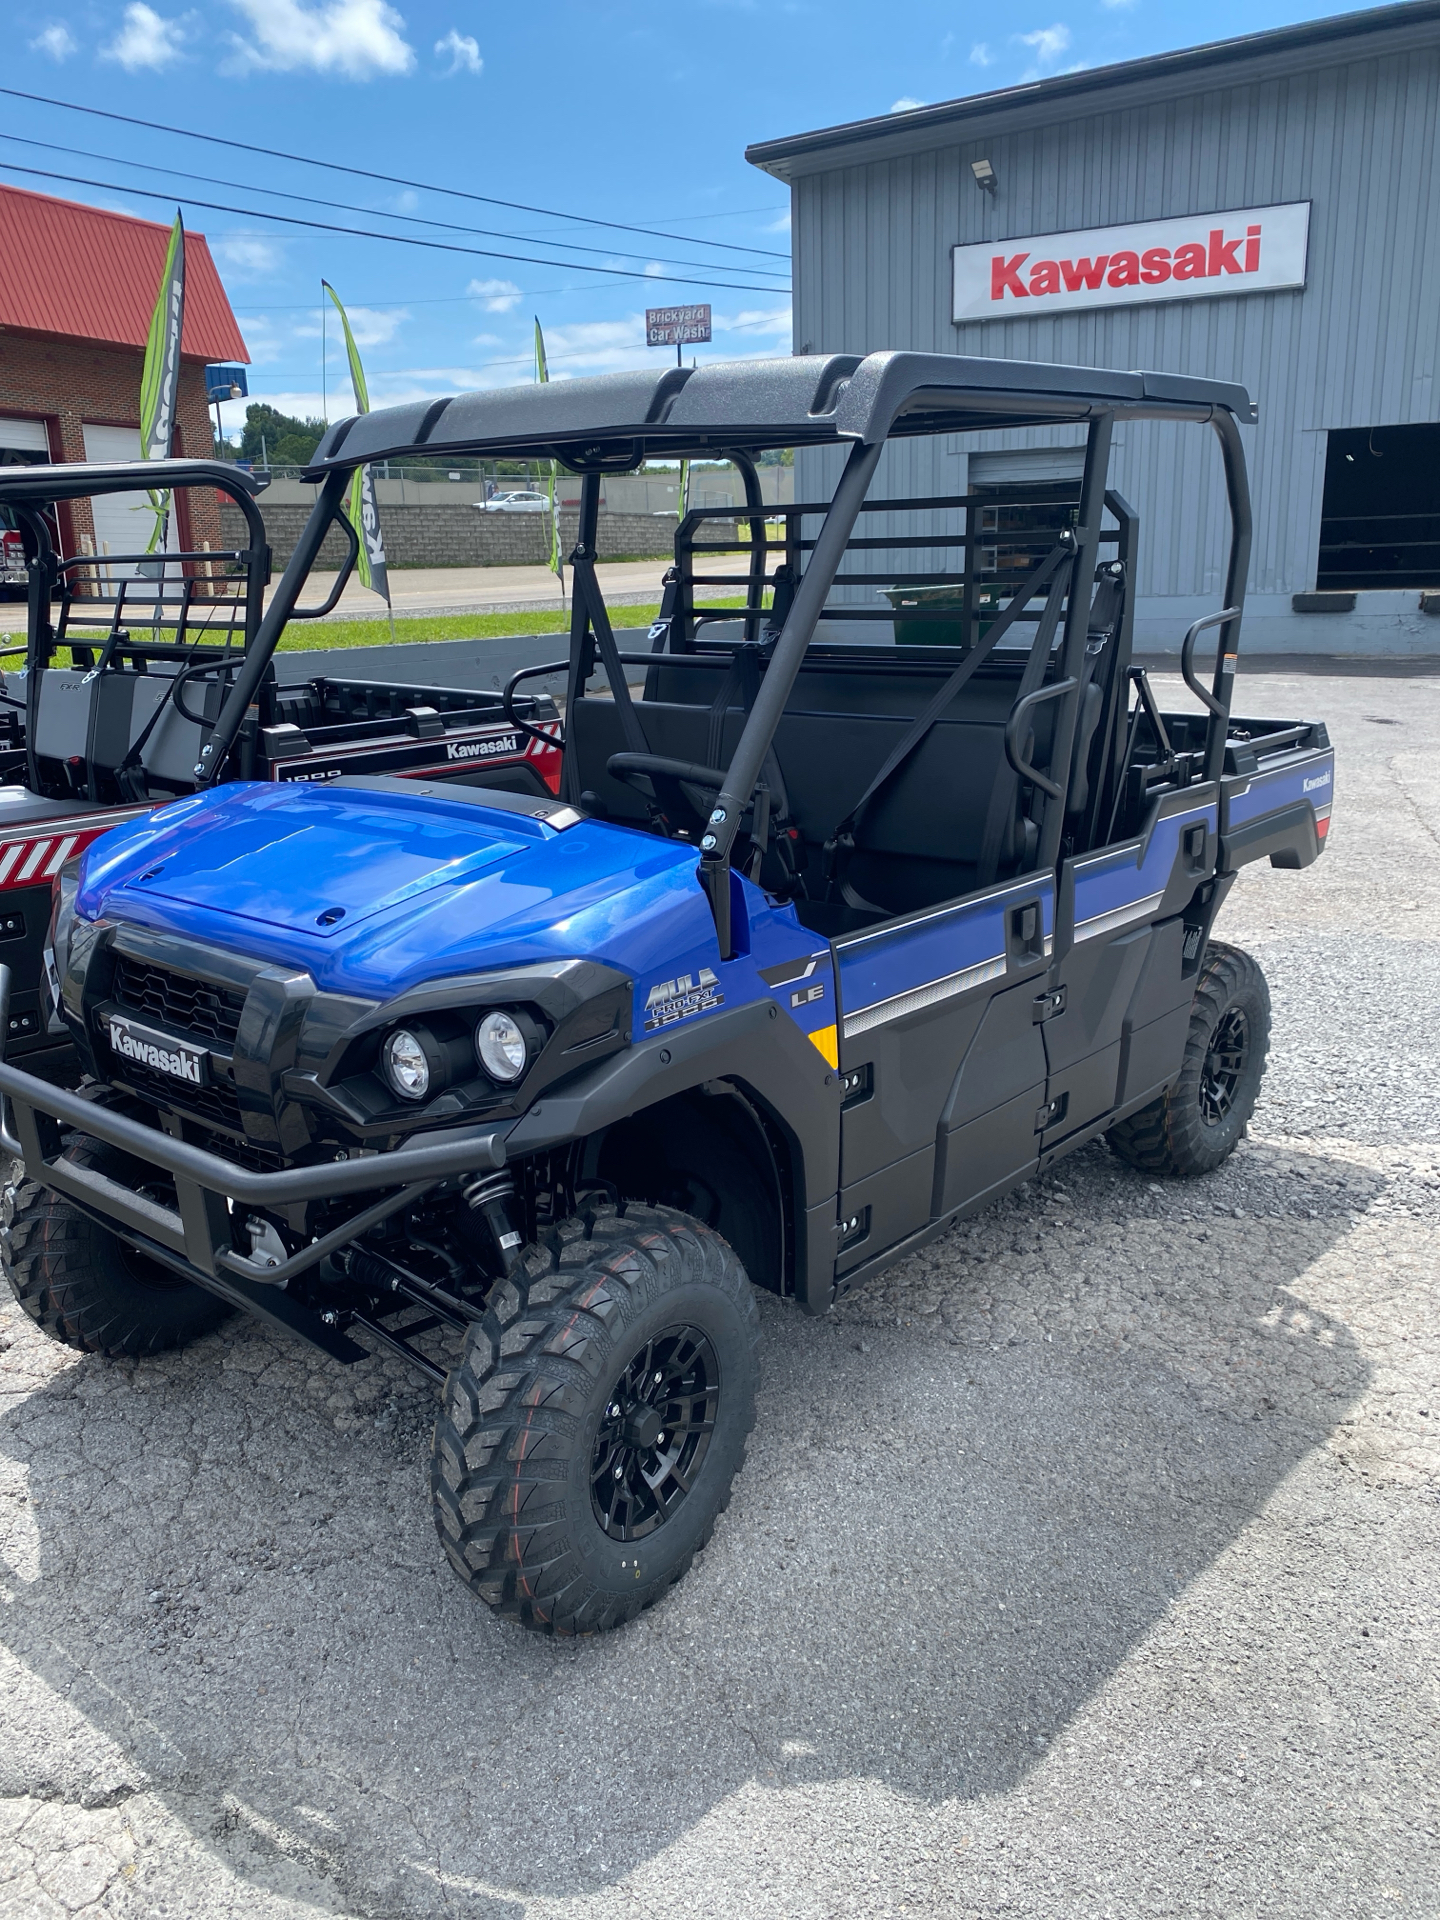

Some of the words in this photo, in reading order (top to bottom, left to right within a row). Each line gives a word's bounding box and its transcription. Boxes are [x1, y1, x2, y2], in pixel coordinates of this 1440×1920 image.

[991, 225, 1262, 300] Kawasaki
[649, 308, 704, 323] Brickyard
[650, 328, 670, 341] Car
[673, 325, 705, 340] Wash
[447, 736, 517, 759] Kawasaki
[1302, 770, 1331, 793] Kawasaki
[644, 967, 721, 1011] MULE
[791, 985, 824, 1008] LE
[110, 1024, 201, 1083] Kawasaki
